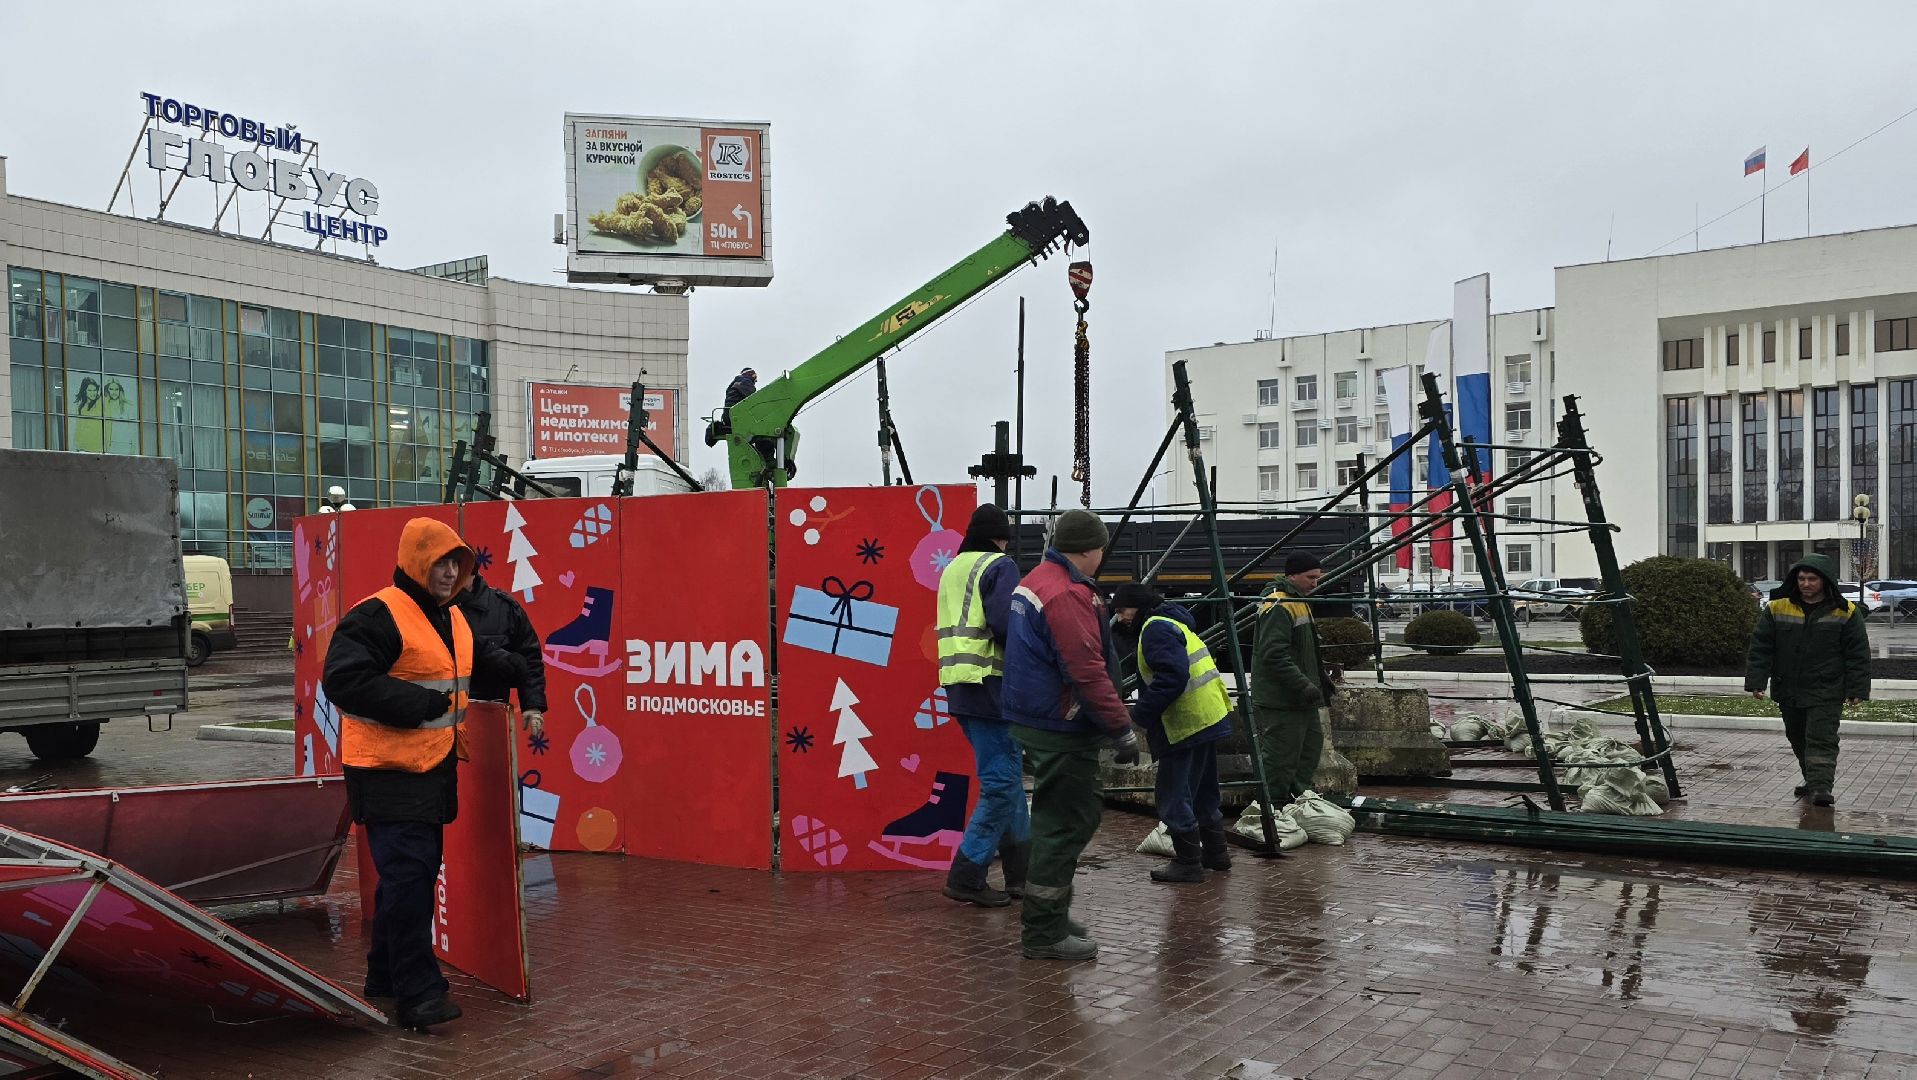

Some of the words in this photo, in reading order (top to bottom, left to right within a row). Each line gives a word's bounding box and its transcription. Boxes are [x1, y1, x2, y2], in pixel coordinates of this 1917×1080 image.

[140, 91, 301, 153] ТОРГОВЫЙ
[585, 129, 628, 140] ЗАГЛЯНИ
[585, 141, 597, 151] ЗА
[600, 140, 643, 152] ВКУСНОЙ
[586, 152, 636, 165] КУРОЧКОЙ
[147, 128, 379, 216] ГЛОБУС
[710, 172, 751, 180] ROSTIC'S
[303, 210, 388, 247] ЦЕНТР
[710, 241, 720, 250] ТЦ
[720, 241, 753, 250] «ГЛОБУС»
[540, 397, 589, 418] Центр
[540, 416, 657, 430] недвижимои
[540, 430, 550, 441] и
[554, 431, 619, 443] ипотеки
[625, 638, 766, 687] ЗИМА
[626, 695, 637, 711] В
[640, 695, 766, 717] ПОДМОСКОВЬЕ
